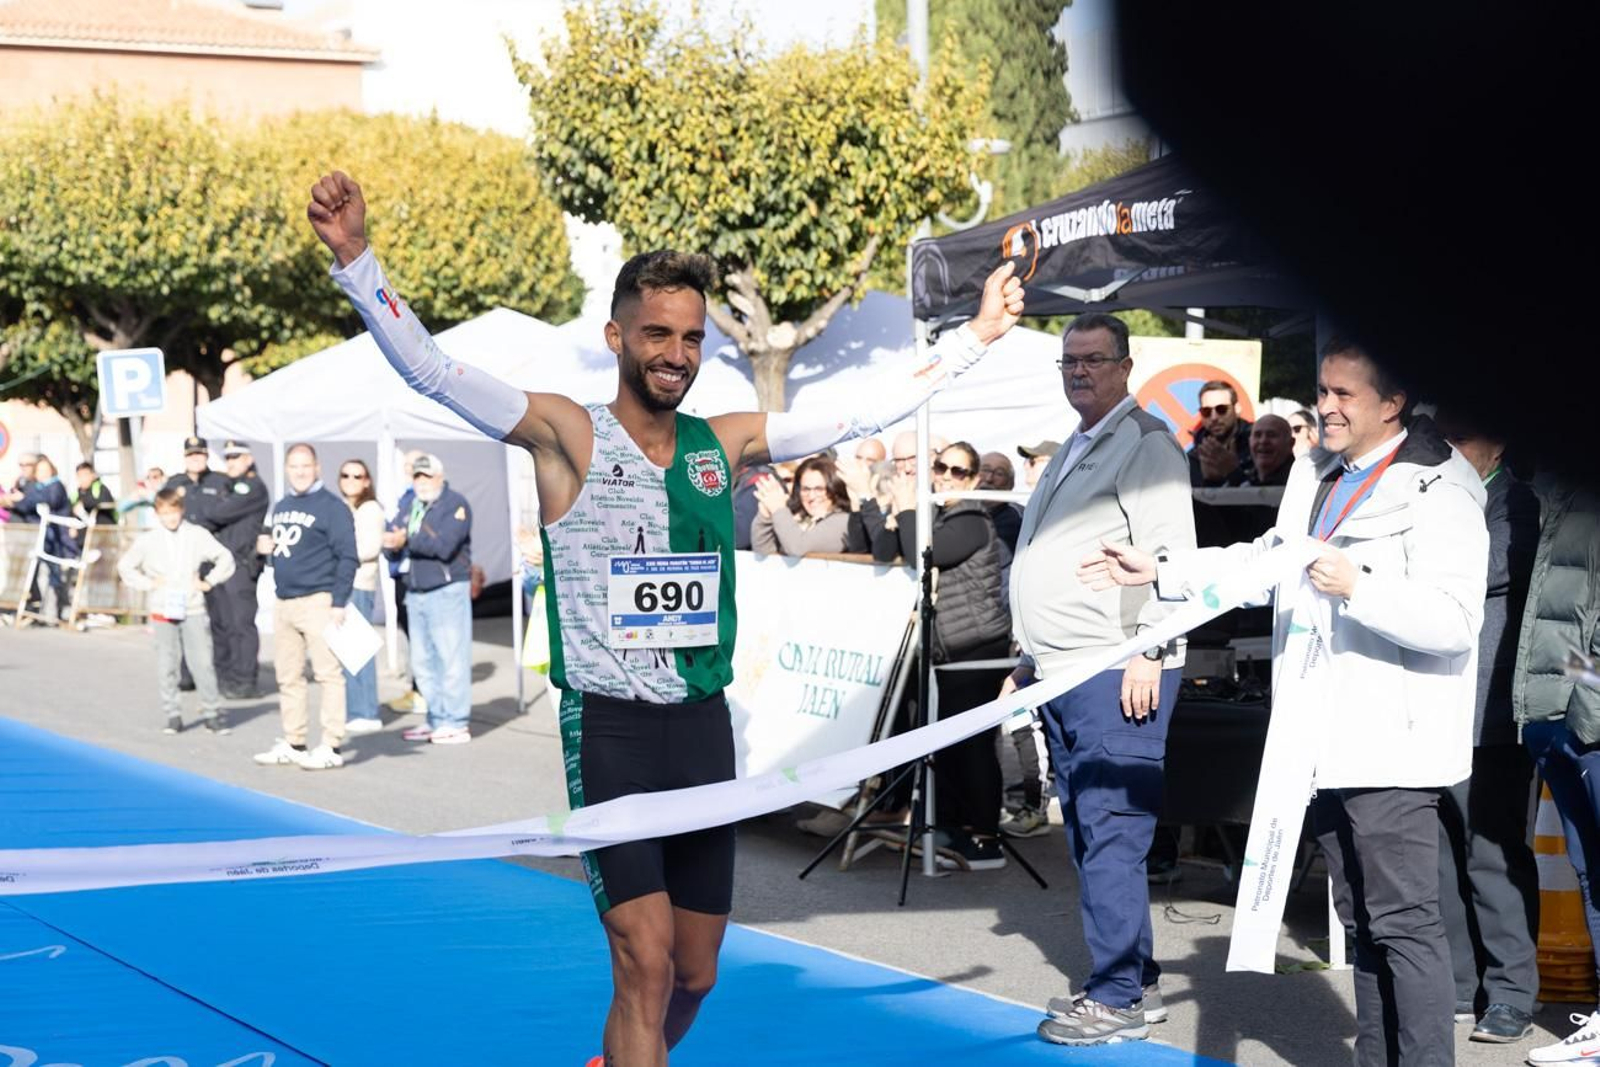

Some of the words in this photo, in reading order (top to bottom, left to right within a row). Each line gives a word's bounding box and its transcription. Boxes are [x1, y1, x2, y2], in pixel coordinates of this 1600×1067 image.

[111, 357, 152, 410] P
[602, 477, 635, 488] VIATOR
[634, 581, 704, 613] 690
[824, 648, 883, 687] RURAL
[1272, 851, 1279, 862] de
[1275, 829, 1284, 850] Jaén
[1251, 872, 1266, 912] Patronato
[1260, 830, 1276, 871] Municipal
[1270, 817, 1278, 829] de
[1262, 865, 1276, 902] Deportes
